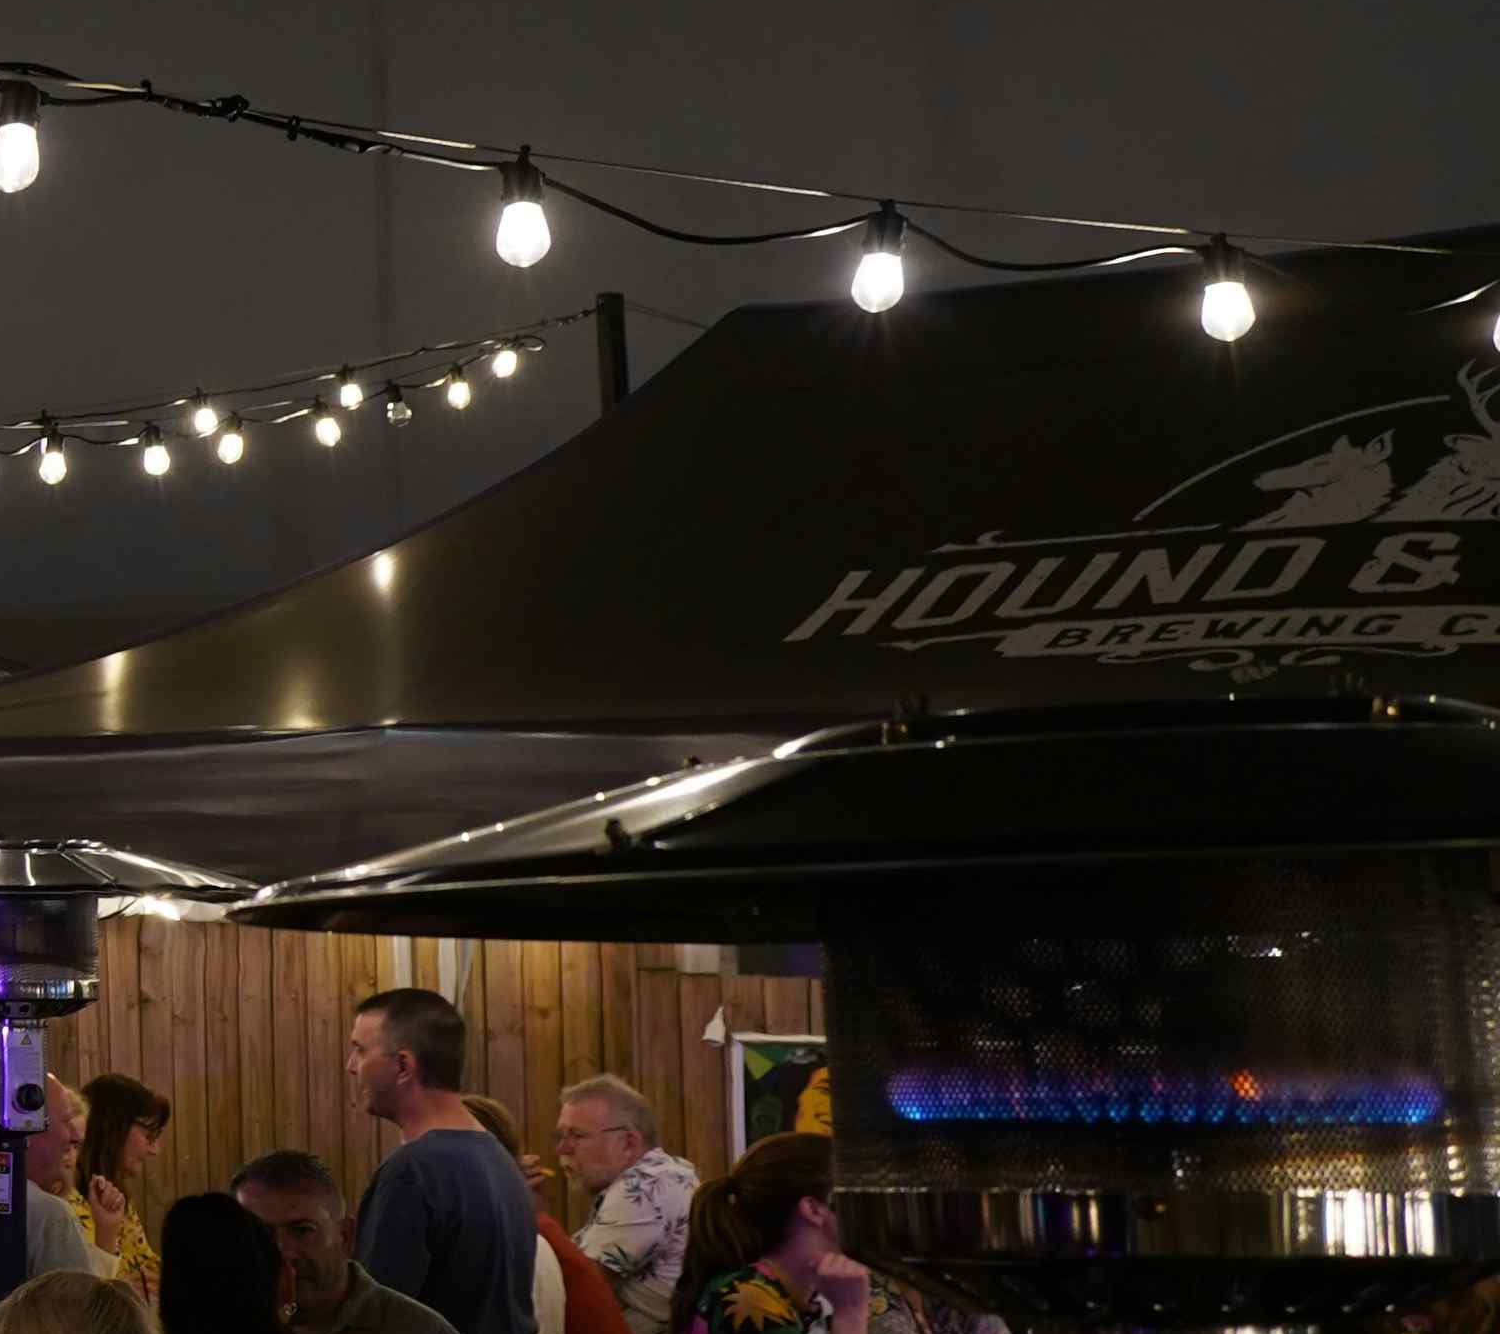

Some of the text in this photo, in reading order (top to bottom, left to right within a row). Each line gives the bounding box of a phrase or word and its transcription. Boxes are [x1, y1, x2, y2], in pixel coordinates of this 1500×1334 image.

[781, 531, 1461, 643] HOUND &
[1045, 612, 1500, 649] BREWING C
